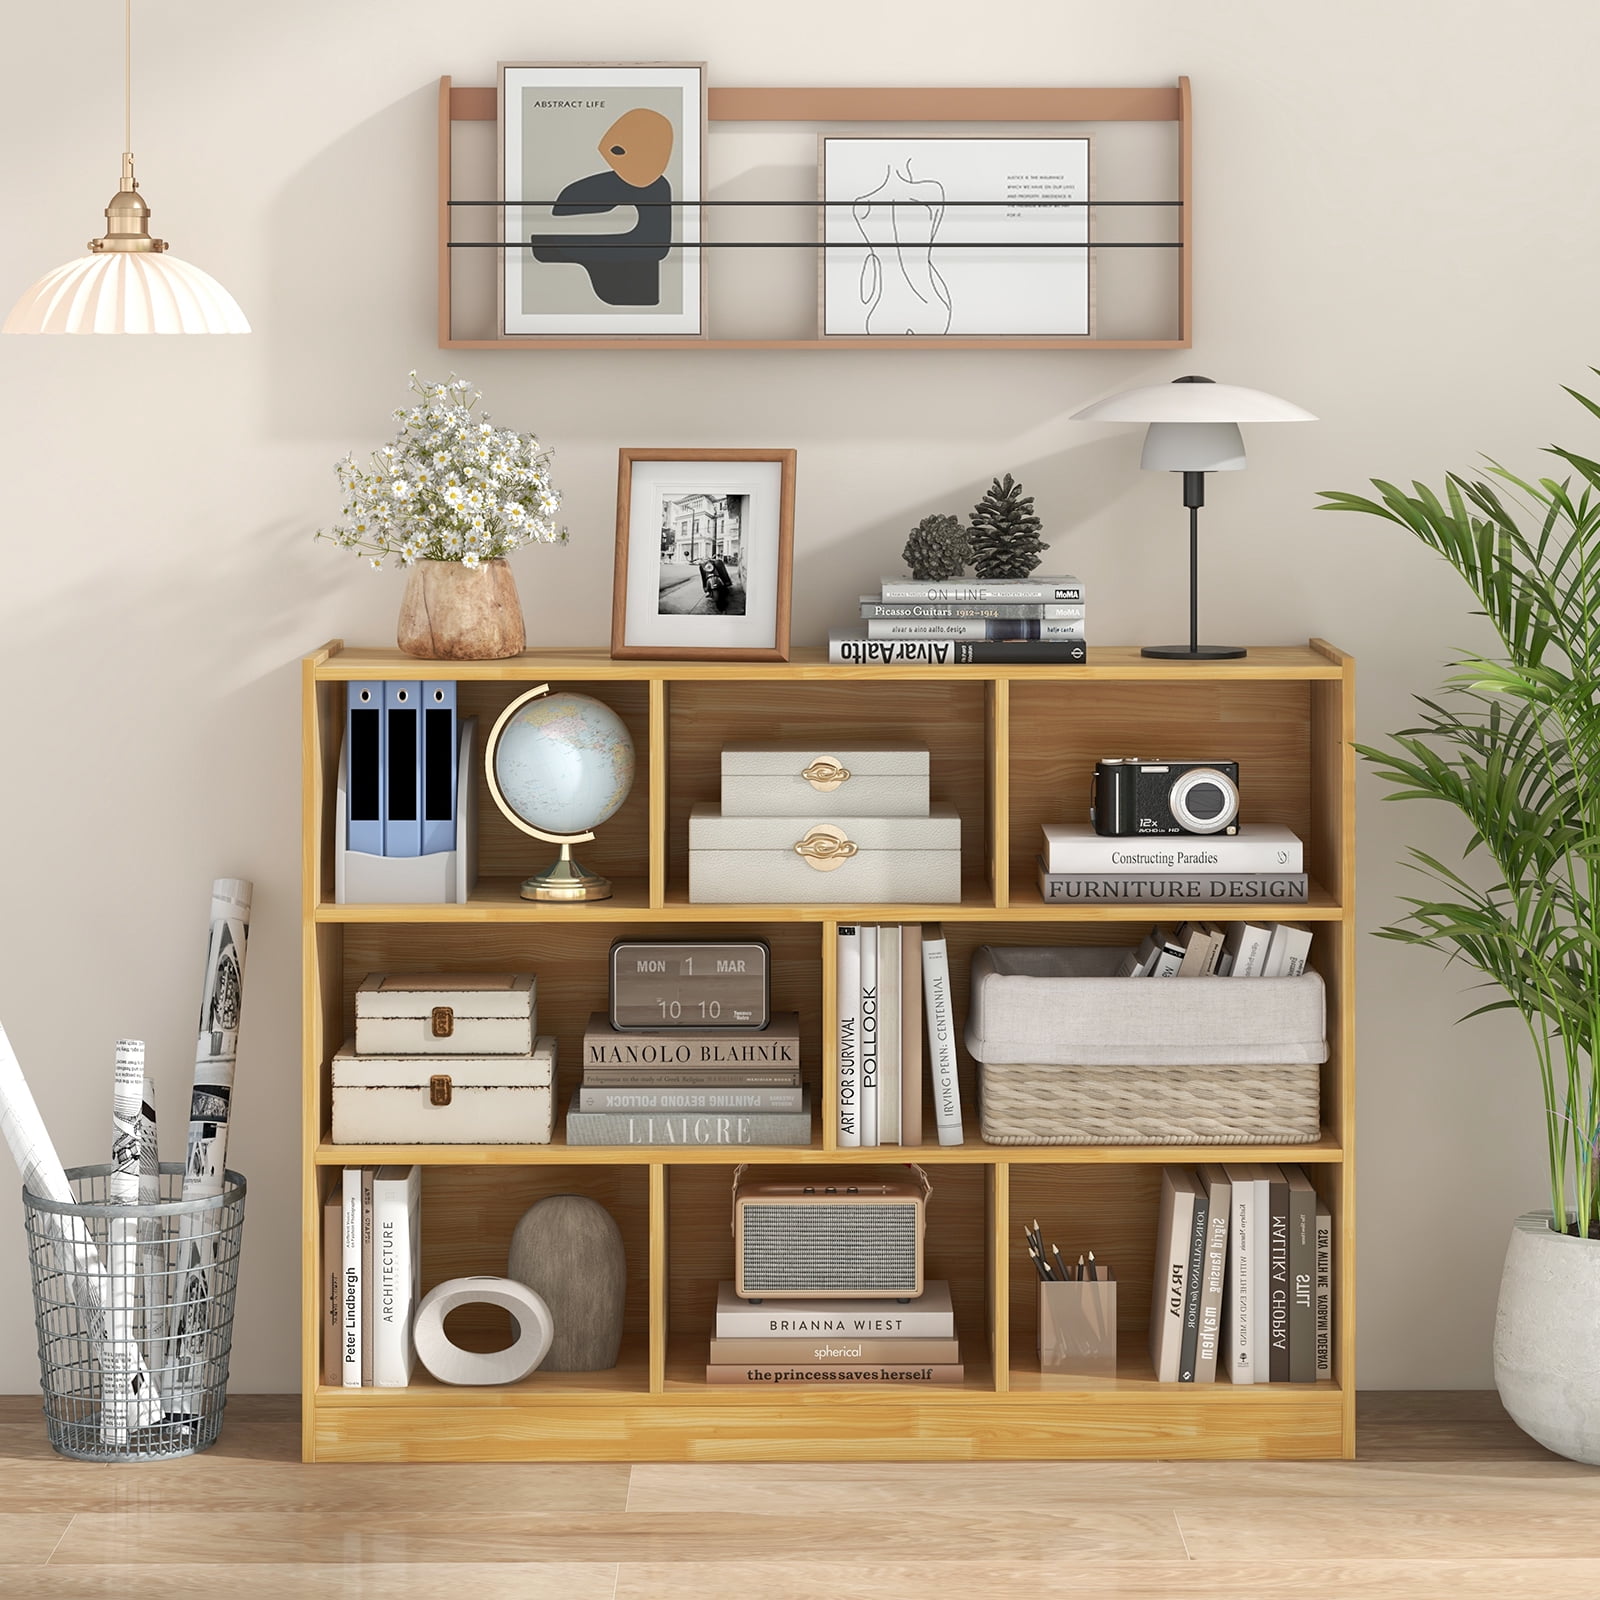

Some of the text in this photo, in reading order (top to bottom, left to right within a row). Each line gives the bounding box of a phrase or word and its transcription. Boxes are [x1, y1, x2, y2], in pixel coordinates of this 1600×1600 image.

[533, 100, 606, 109] ABSTRACT LIFE
[927, 588, 948, 601] ON
[955, 588, 987, 601] LINE
[1055, 590, 1079, 599] MoMA
[875, 605, 911, 616] Picasso
[913, 605, 952, 616] Guitars
[1055, 608, 1080, 616] MoMA
[1139, 818, 1158, 827] 12x
[1111, 851, 1218, 867] Constructing Paradies
[1049, 880, 1305, 898] FURNITURE DESIGN
[636, 957, 746, 976] MON 1 MAR
[658, 1000, 721, 1019] 10 10
[933, 975, 948, 1042] CENTENNIAL
[862, 986, 877, 1088] POLLOCK
[589, 1041, 793, 1064] MANOLO BLAHNÍK
[938, 1044, 951, 1075] PENN:
[840, 1017, 855, 1135] ART FOR SURVIVAL
[606, 1095, 657, 1107] POLLOCK
[660, 1095, 706, 1107] BEYOND
[709, 1095, 761, 1107] PAINTING
[941, 1078, 954, 1117] IRVING
[628, 1118, 751, 1144] LIAIGRE
[383, 1221, 394, 1323] ARCHITECTURE
[345, 1267, 359, 1363] Peter Lindbergh
[770, 1320, 903, 1331] BRIANNA WIEST
[813, 1344, 862, 1360] spherical
[747, 1369, 772, 1380] the
[880, 1368, 934, 1380] herself
